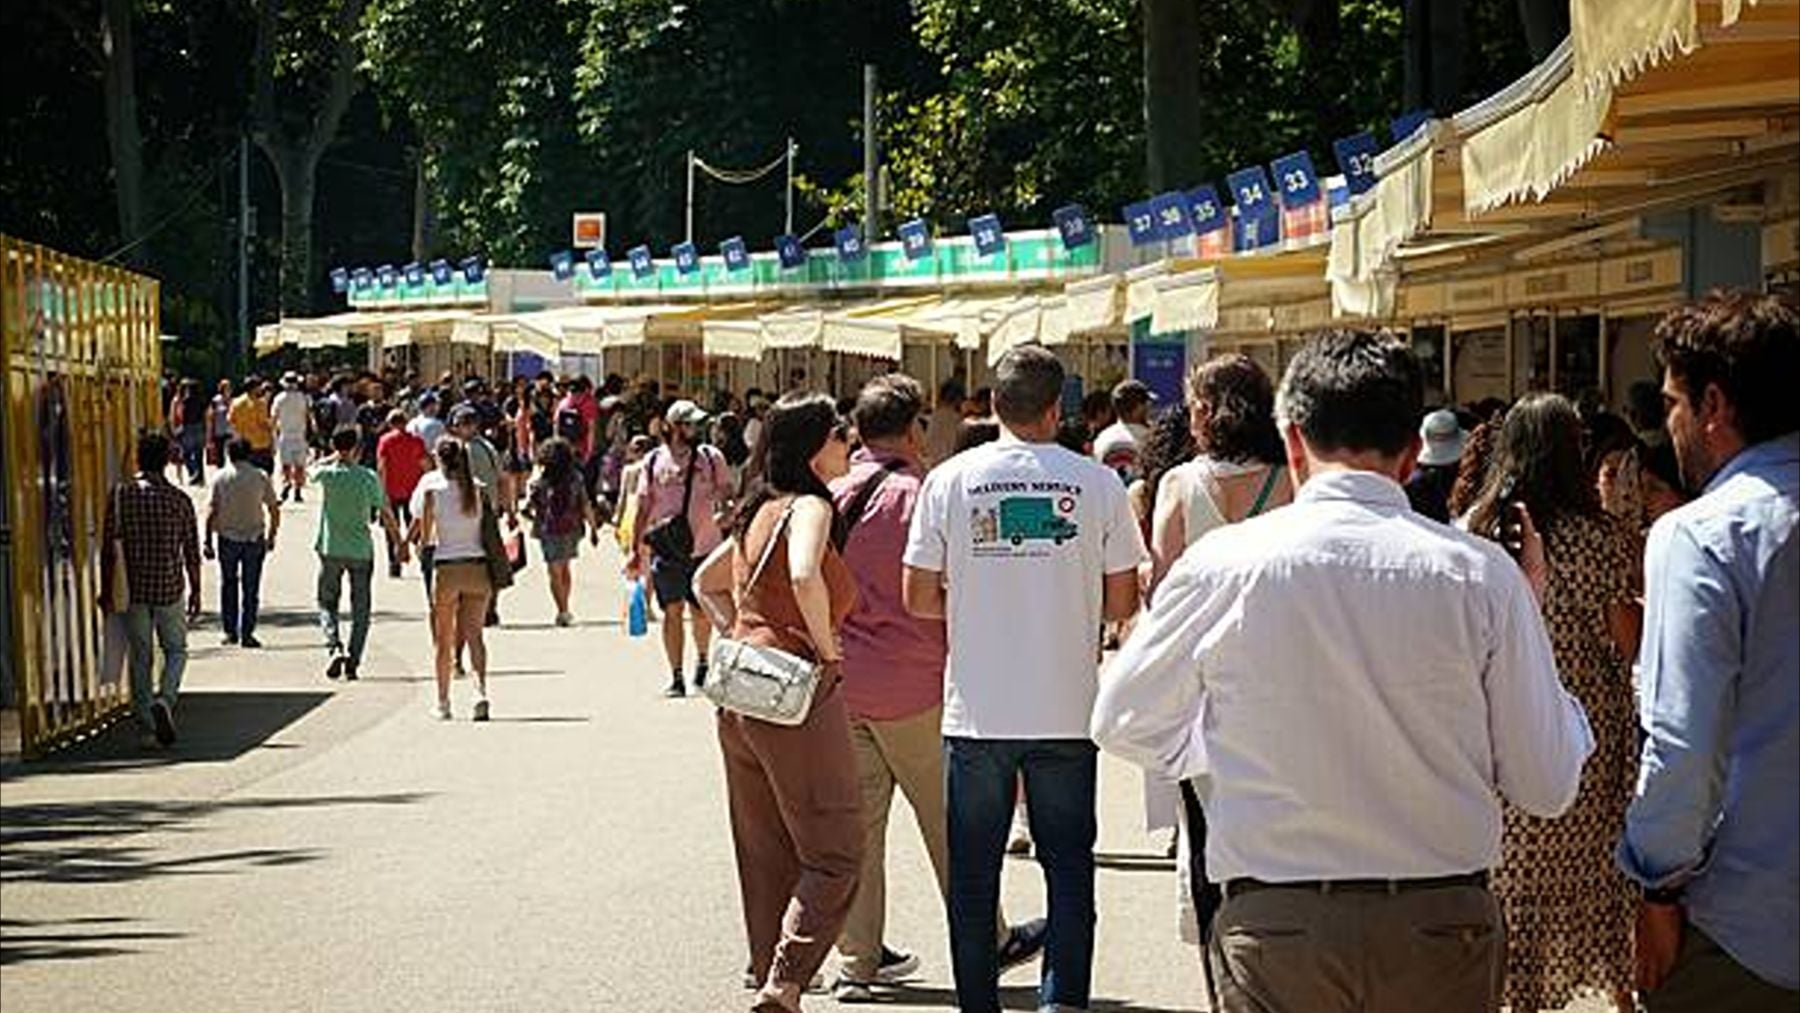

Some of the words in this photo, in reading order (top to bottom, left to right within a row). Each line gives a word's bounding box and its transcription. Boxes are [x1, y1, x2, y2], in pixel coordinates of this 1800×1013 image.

[1349, 153, 1374, 176] 32
[1284, 169, 1309, 192] 33
[1240, 182, 1263, 205] 34
[1193, 200, 1216, 222] 35
[1133, 213, 1151, 232] 37
[966, 482, 1028, 495] DELIVERY
[1031, 482, 1082, 495] SERVICE
